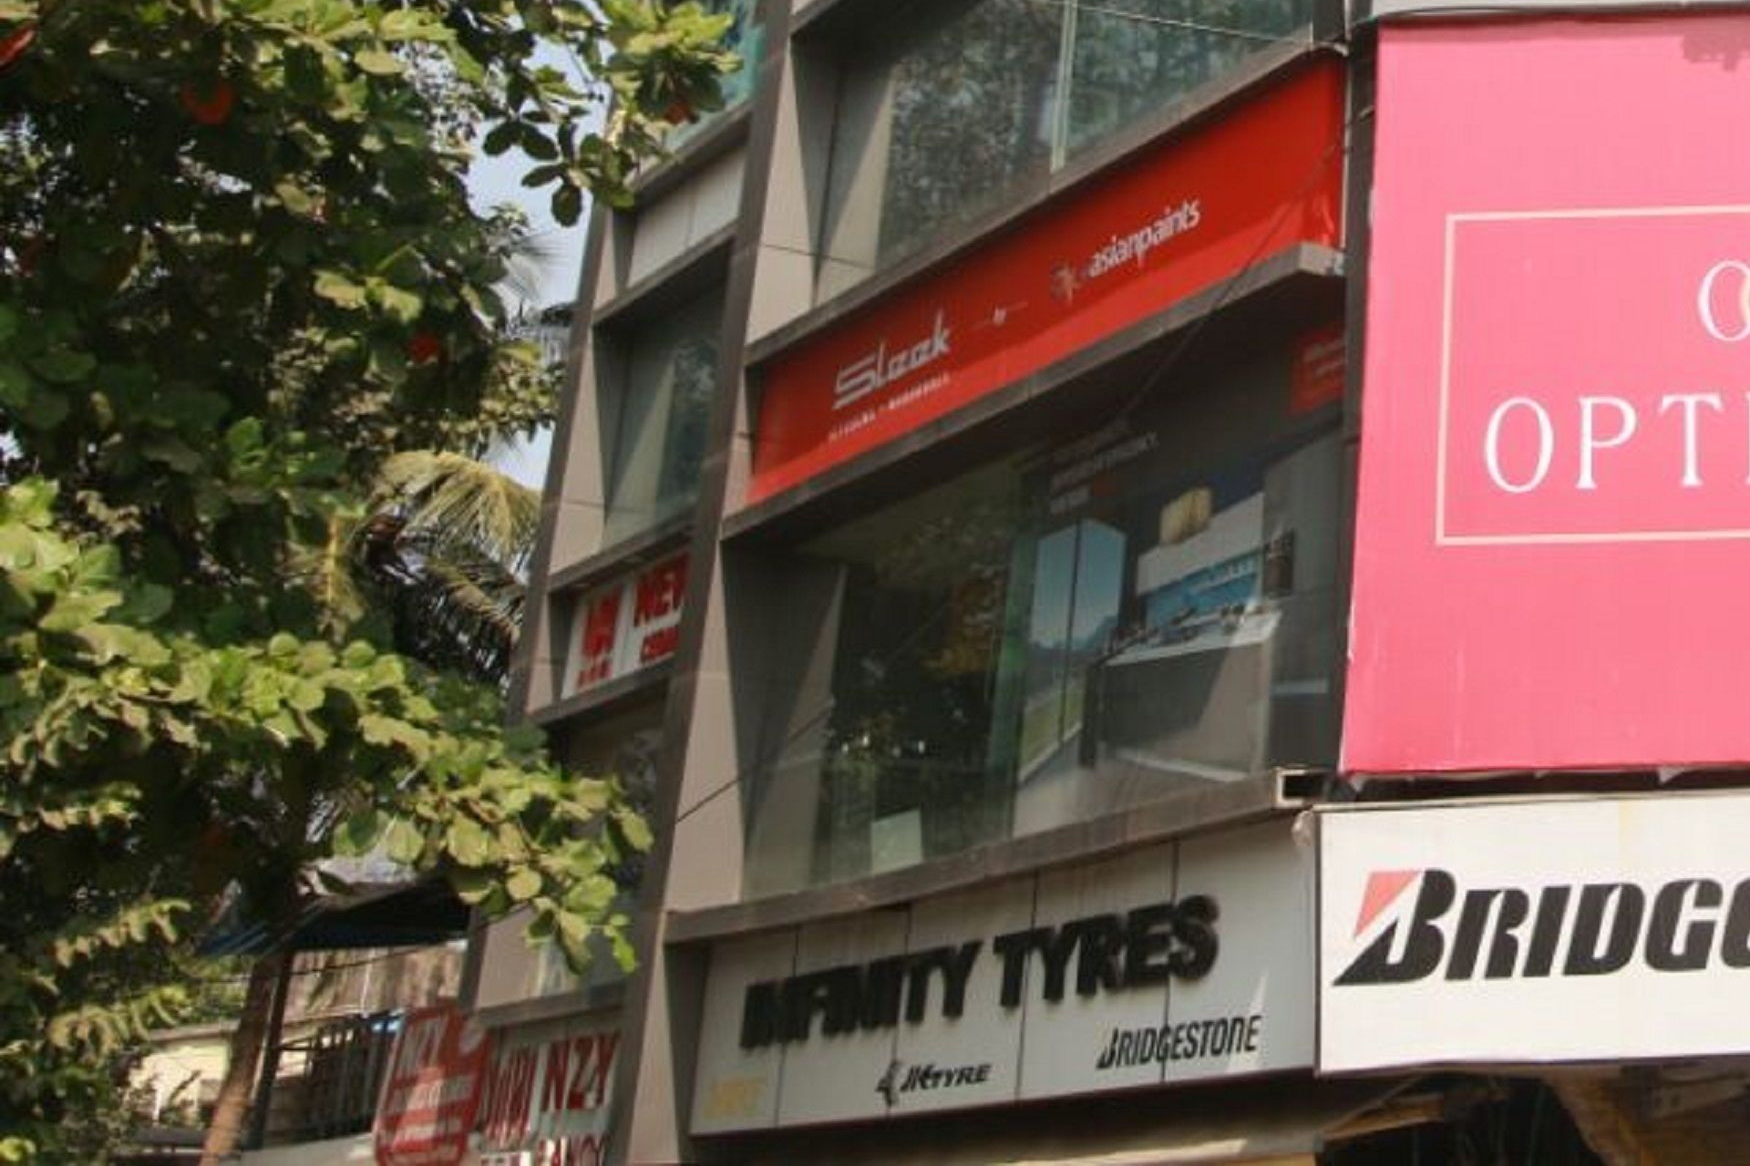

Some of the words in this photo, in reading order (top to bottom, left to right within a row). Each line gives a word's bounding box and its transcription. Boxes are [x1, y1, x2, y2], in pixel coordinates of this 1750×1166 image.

[1088, 198, 1201, 270] asianpaints
[740, 940, 984, 1050] INFINITY
[993, 894, 1221, 1010] TYRES
[541, 1030, 622, 1112] NZY
[1097, 1015, 1262, 1070] BRIDGESTONE
